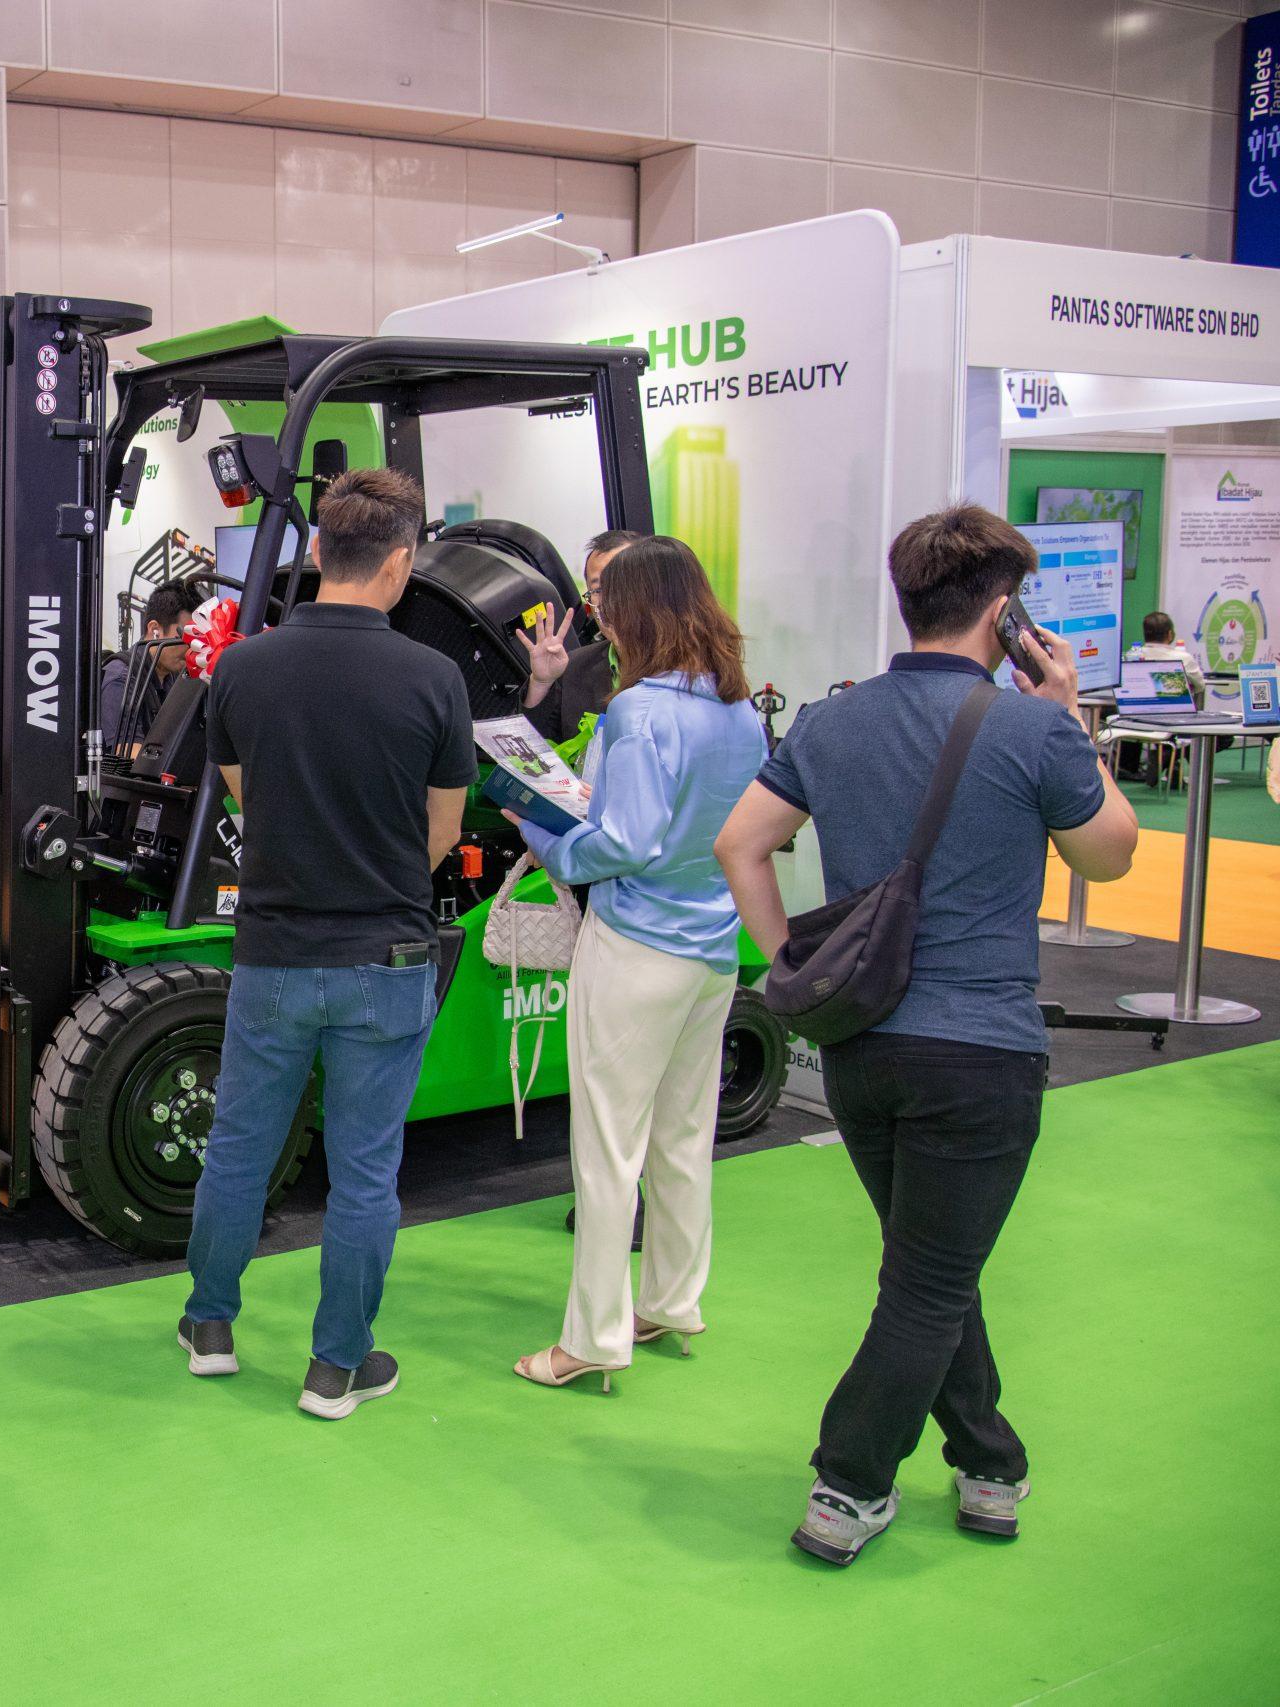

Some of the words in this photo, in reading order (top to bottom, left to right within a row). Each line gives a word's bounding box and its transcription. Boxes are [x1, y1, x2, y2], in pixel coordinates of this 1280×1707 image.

[1250, 47, 1272, 121] Toilets
[1050, 294, 1110, 326] PANTAS
[1114, 301, 1194, 333] SOFTWARE
[1198, 309, 1226, 335] SDN
[1230, 313, 1260, 338] BHD
[648, 316, 746, 372] HUB
[646, 376, 740, 409] EARTH'S
[747, 361, 849, 397] BEAUTY
[27, 595, 61, 733] iMOW
[497, 969, 520, 980] Allid
[503, 980, 568, 1020] iMO
[789, 1052, 823, 1073] DEAL
